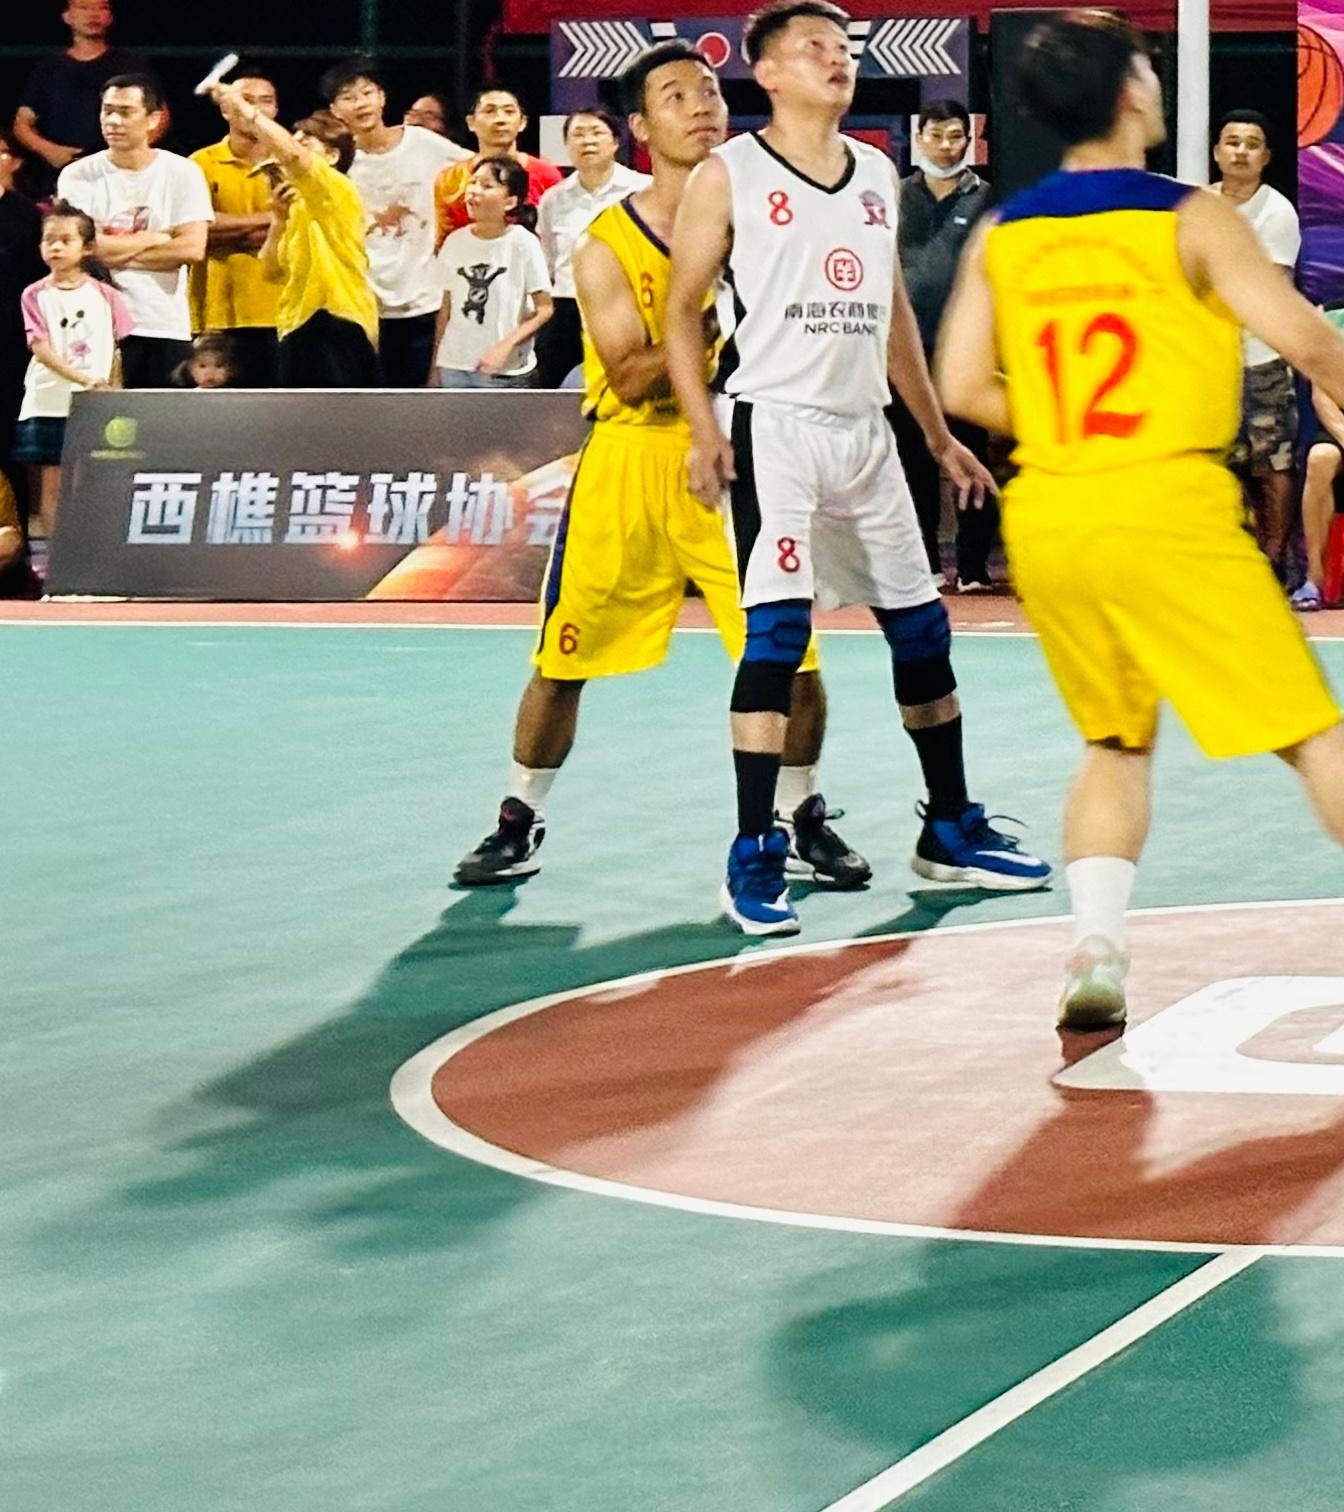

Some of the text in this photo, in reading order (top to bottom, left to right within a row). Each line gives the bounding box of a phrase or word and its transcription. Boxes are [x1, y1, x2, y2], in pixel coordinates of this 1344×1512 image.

[768, 190, 793, 226] 8
[1033, 311, 1153, 446] 12
[777, 536, 801, 573] 8
[558, 622, 581, 656] 6
